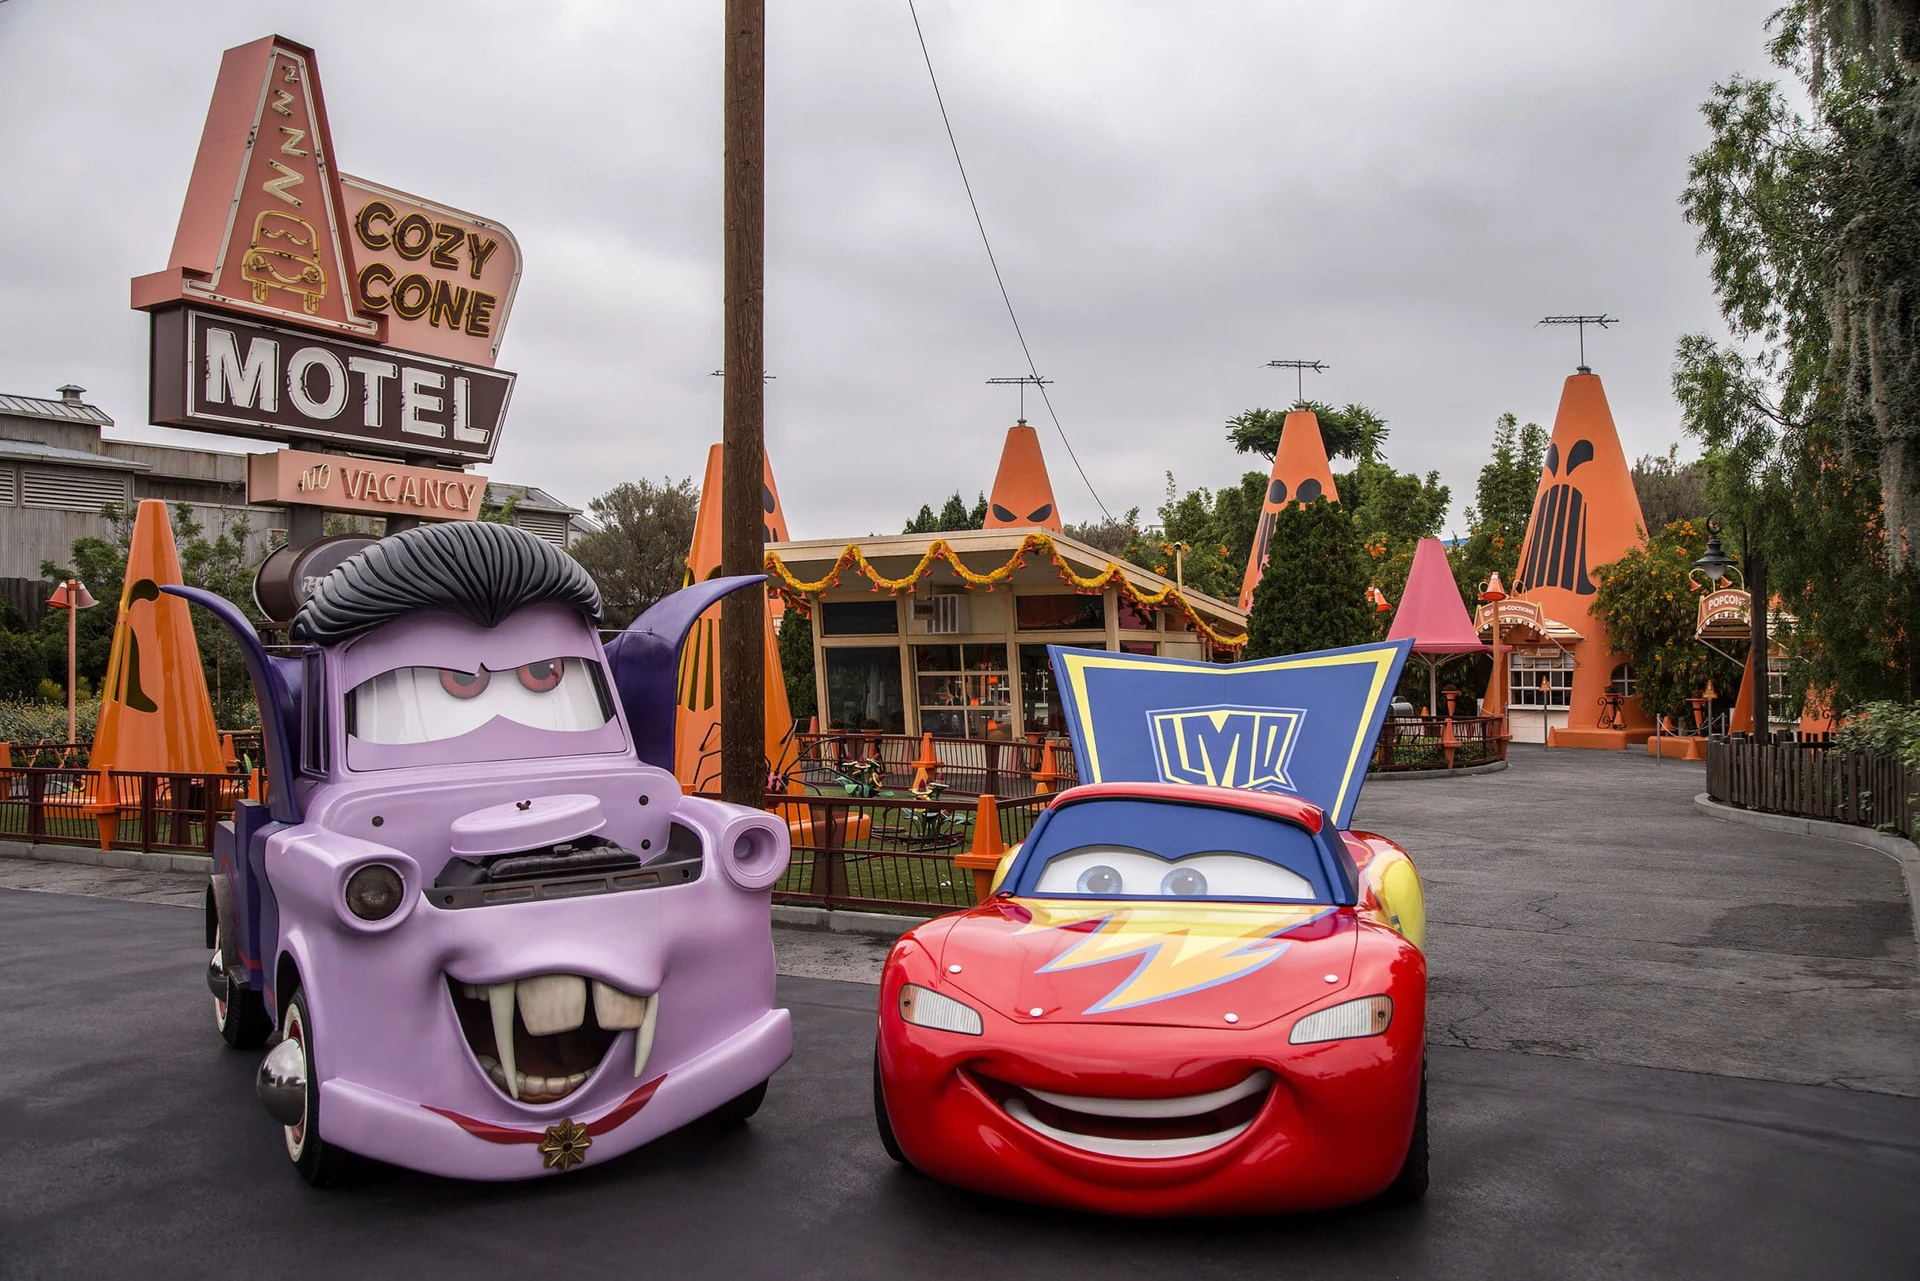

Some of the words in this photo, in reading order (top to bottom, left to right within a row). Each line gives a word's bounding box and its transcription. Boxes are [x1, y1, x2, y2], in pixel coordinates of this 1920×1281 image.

[355, 200, 499, 280] COZY
[358, 262, 497, 338] CONE
[205, 327, 490, 444] MOTEL
[299, 464, 331, 492] NO
[339, 467, 476, 511] VACANCY
